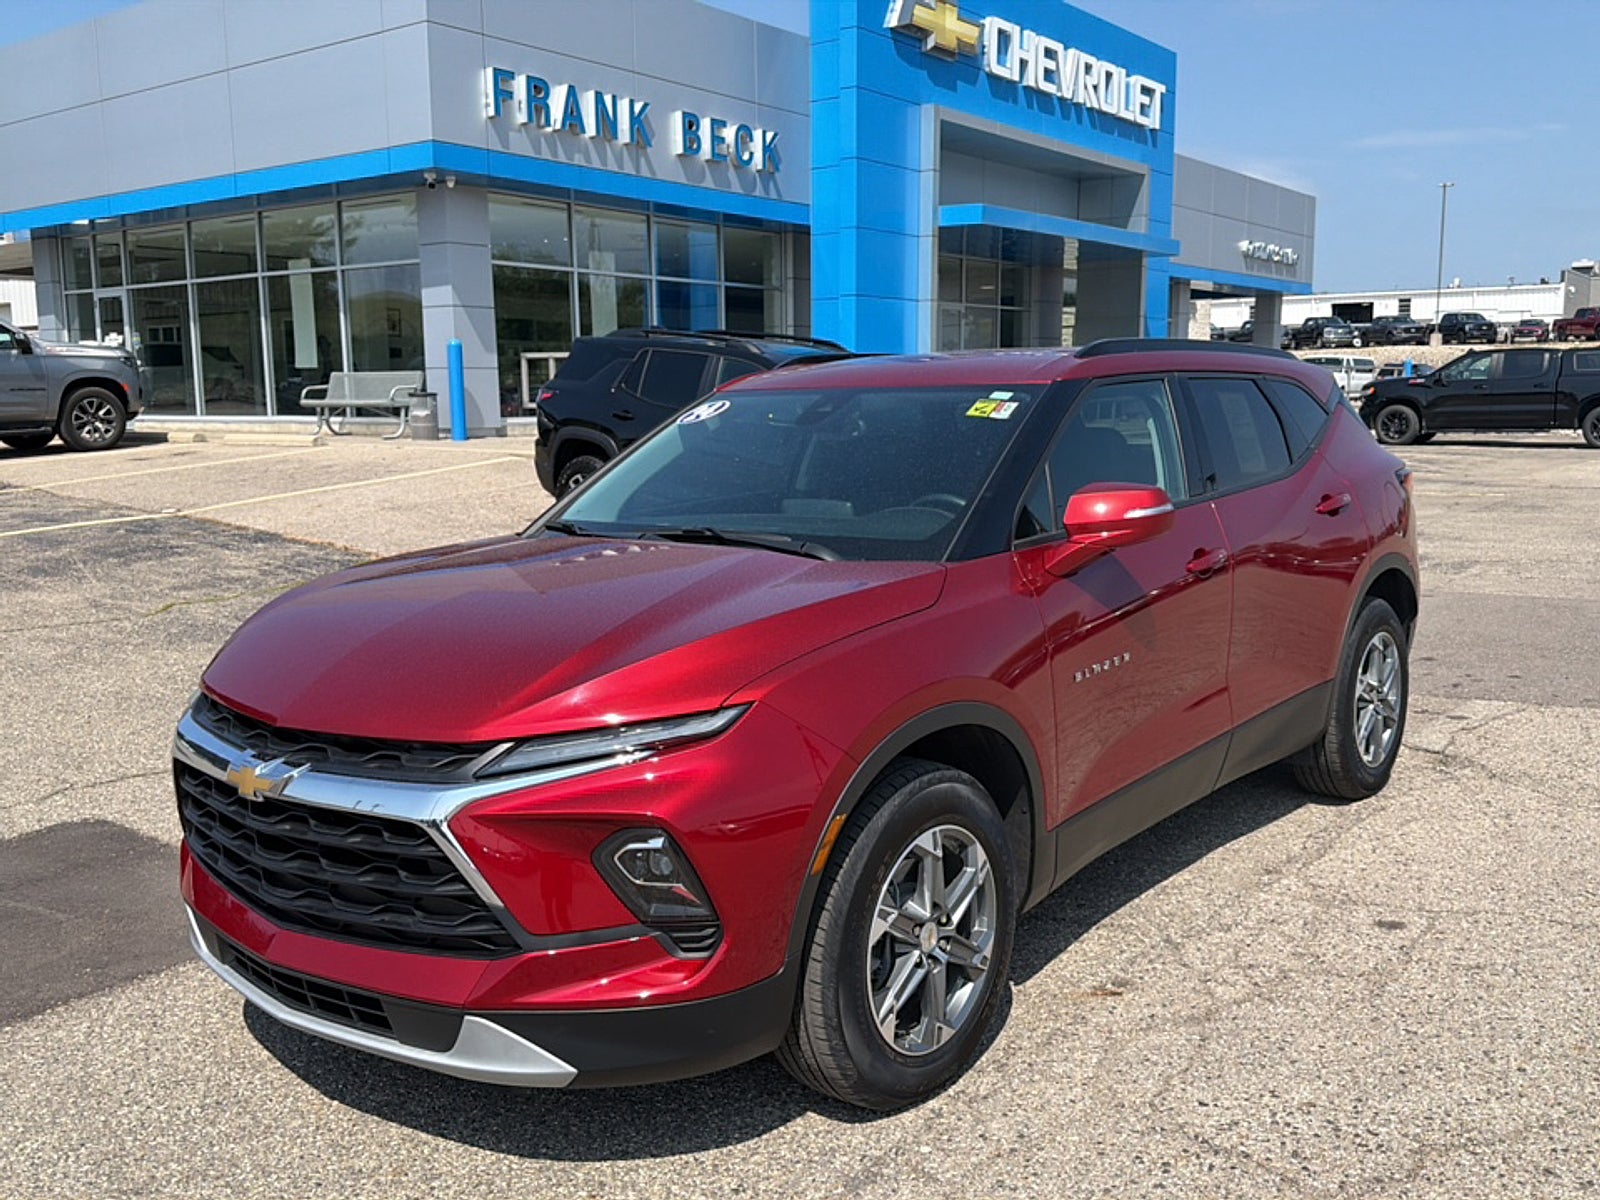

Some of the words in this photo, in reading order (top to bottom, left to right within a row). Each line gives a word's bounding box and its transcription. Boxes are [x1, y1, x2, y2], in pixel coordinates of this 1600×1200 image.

[484, 66, 652, 148] FRANK
[675, 110, 780, 174] BECK
[983, 16, 1166, 130] CHEVROLET
